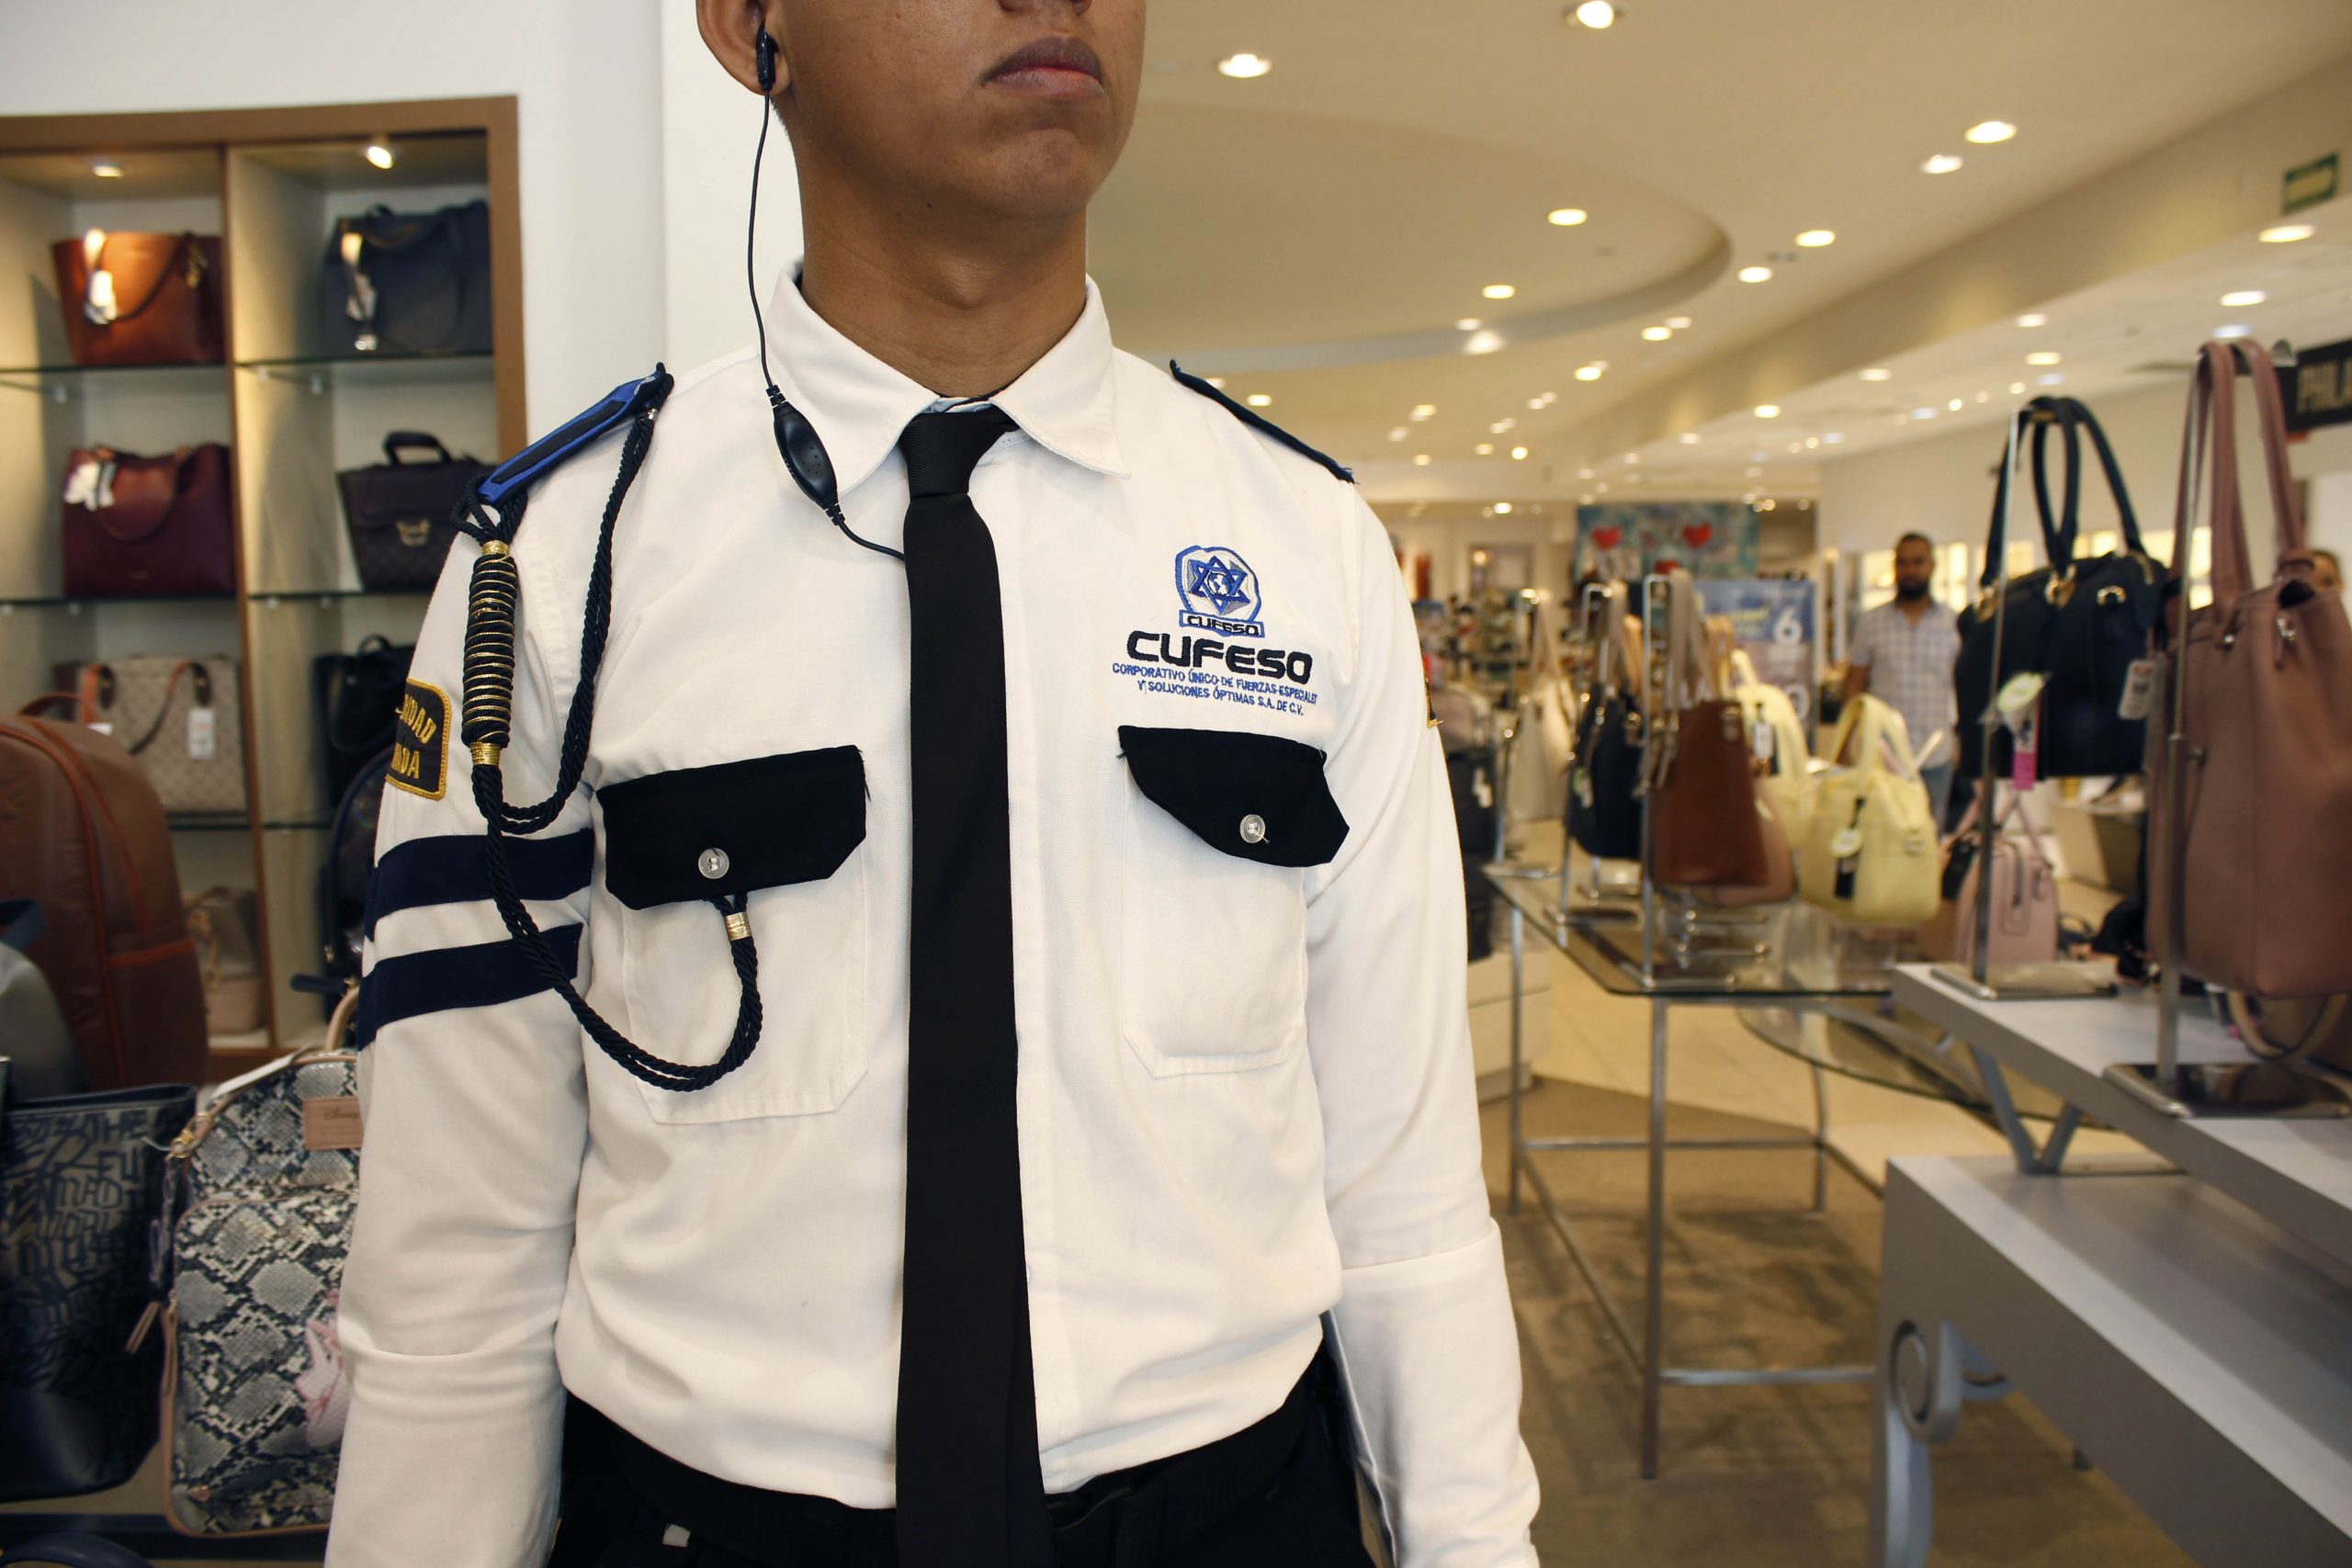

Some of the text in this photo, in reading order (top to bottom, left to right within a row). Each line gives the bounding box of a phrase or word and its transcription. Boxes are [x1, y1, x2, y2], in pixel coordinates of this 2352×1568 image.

[1187, 615, 1259, 636] CUFESO
[1126, 631, 1312, 684] CUFESO
[1113, 662, 1185, 682] CORPORATIVO
[1188, 669, 1219, 685] ÚNICO
[1221, 676, 1234, 687] DE
[1237, 679, 1277, 694] FUERZAS
[1148, 682, 1210, 698] SOLUCIONES
[1213, 686, 1255, 705] ÓPTIMAS
[1258, 696, 1274, 709] S.A.
[1276, 700, 1287, 712] DE
[1289, 703, 1304, 716] C.V.
